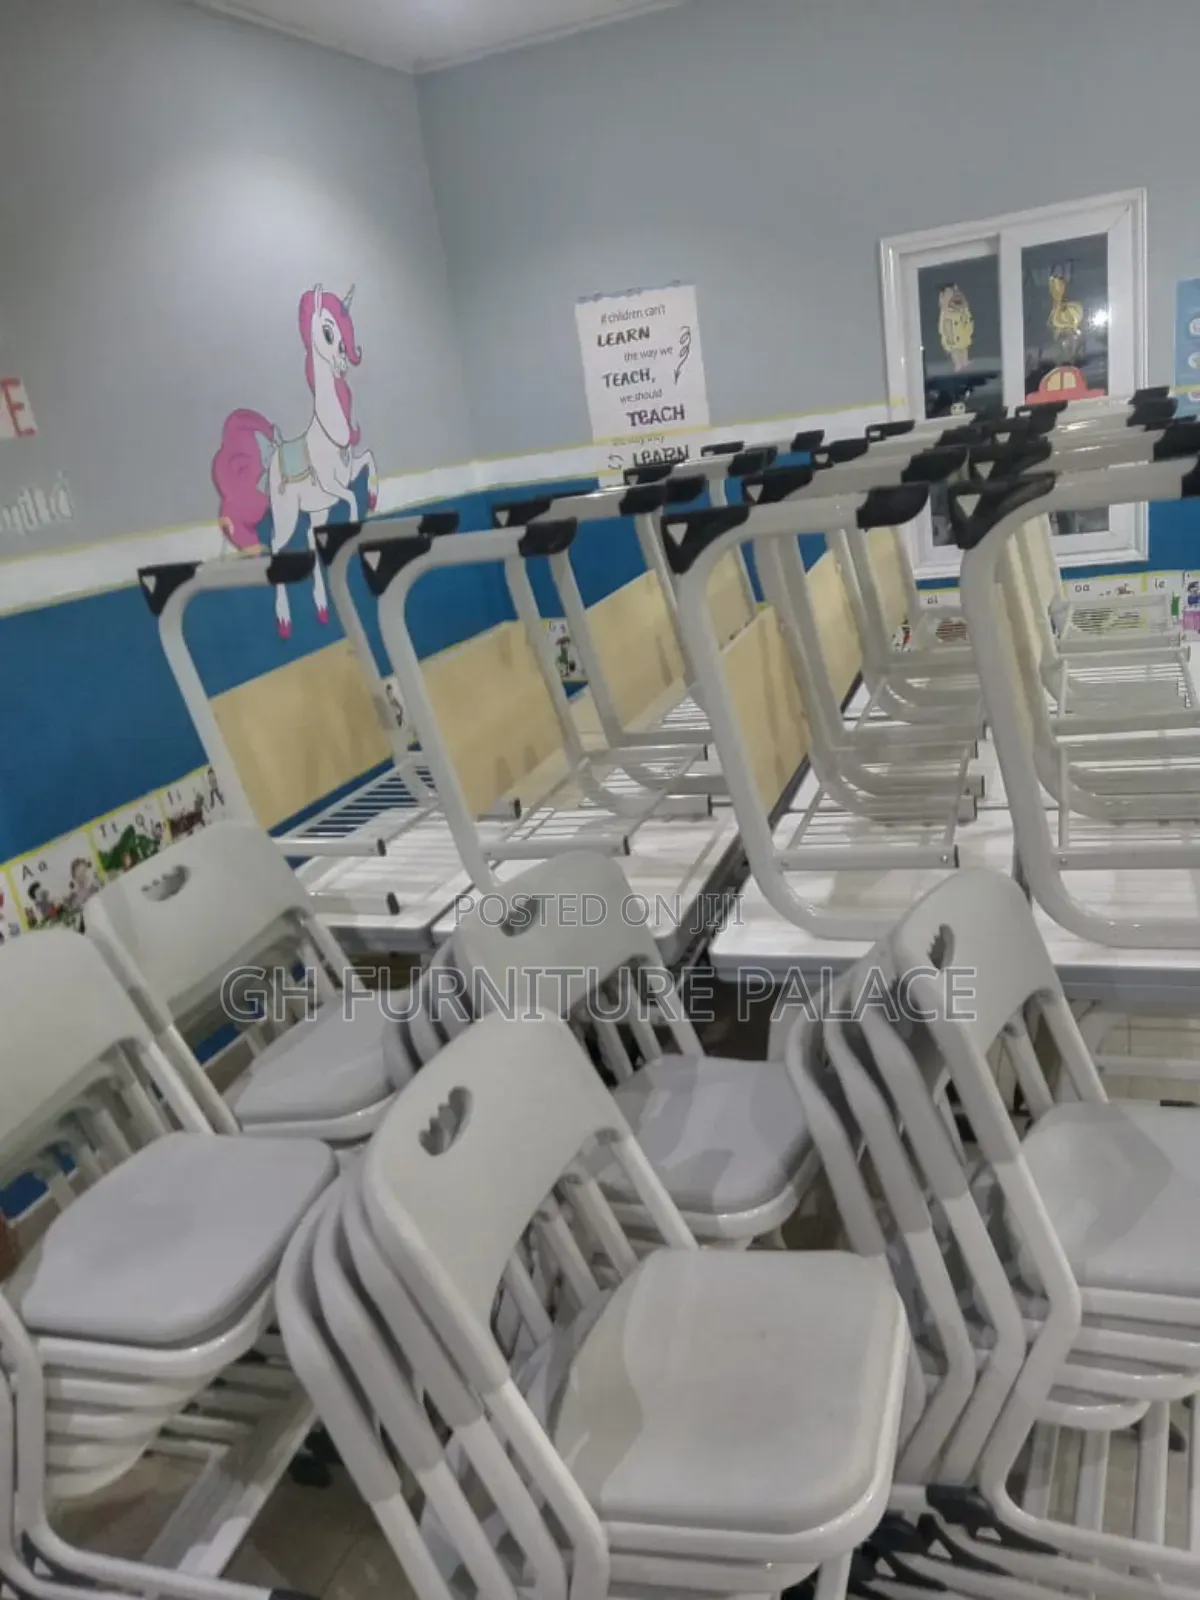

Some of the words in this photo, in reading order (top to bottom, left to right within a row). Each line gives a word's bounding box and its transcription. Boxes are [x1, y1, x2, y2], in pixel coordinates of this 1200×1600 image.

[608, 308, 643, 324] children
[644, 304, 666, 317] can't
[597, 325, 650, 347] LEARN
[624, 351, 638, 362] the
[639, 348, 658, 361] way
[659, 346, 673, 356] we
[602, 367, 656, 389] TEACH,
[620, 394, 634, 404] we
[634, 388, 663, 401] should
[625, 403, 685, 427] TEACH
[632, 444, 690, 466] LEARN
